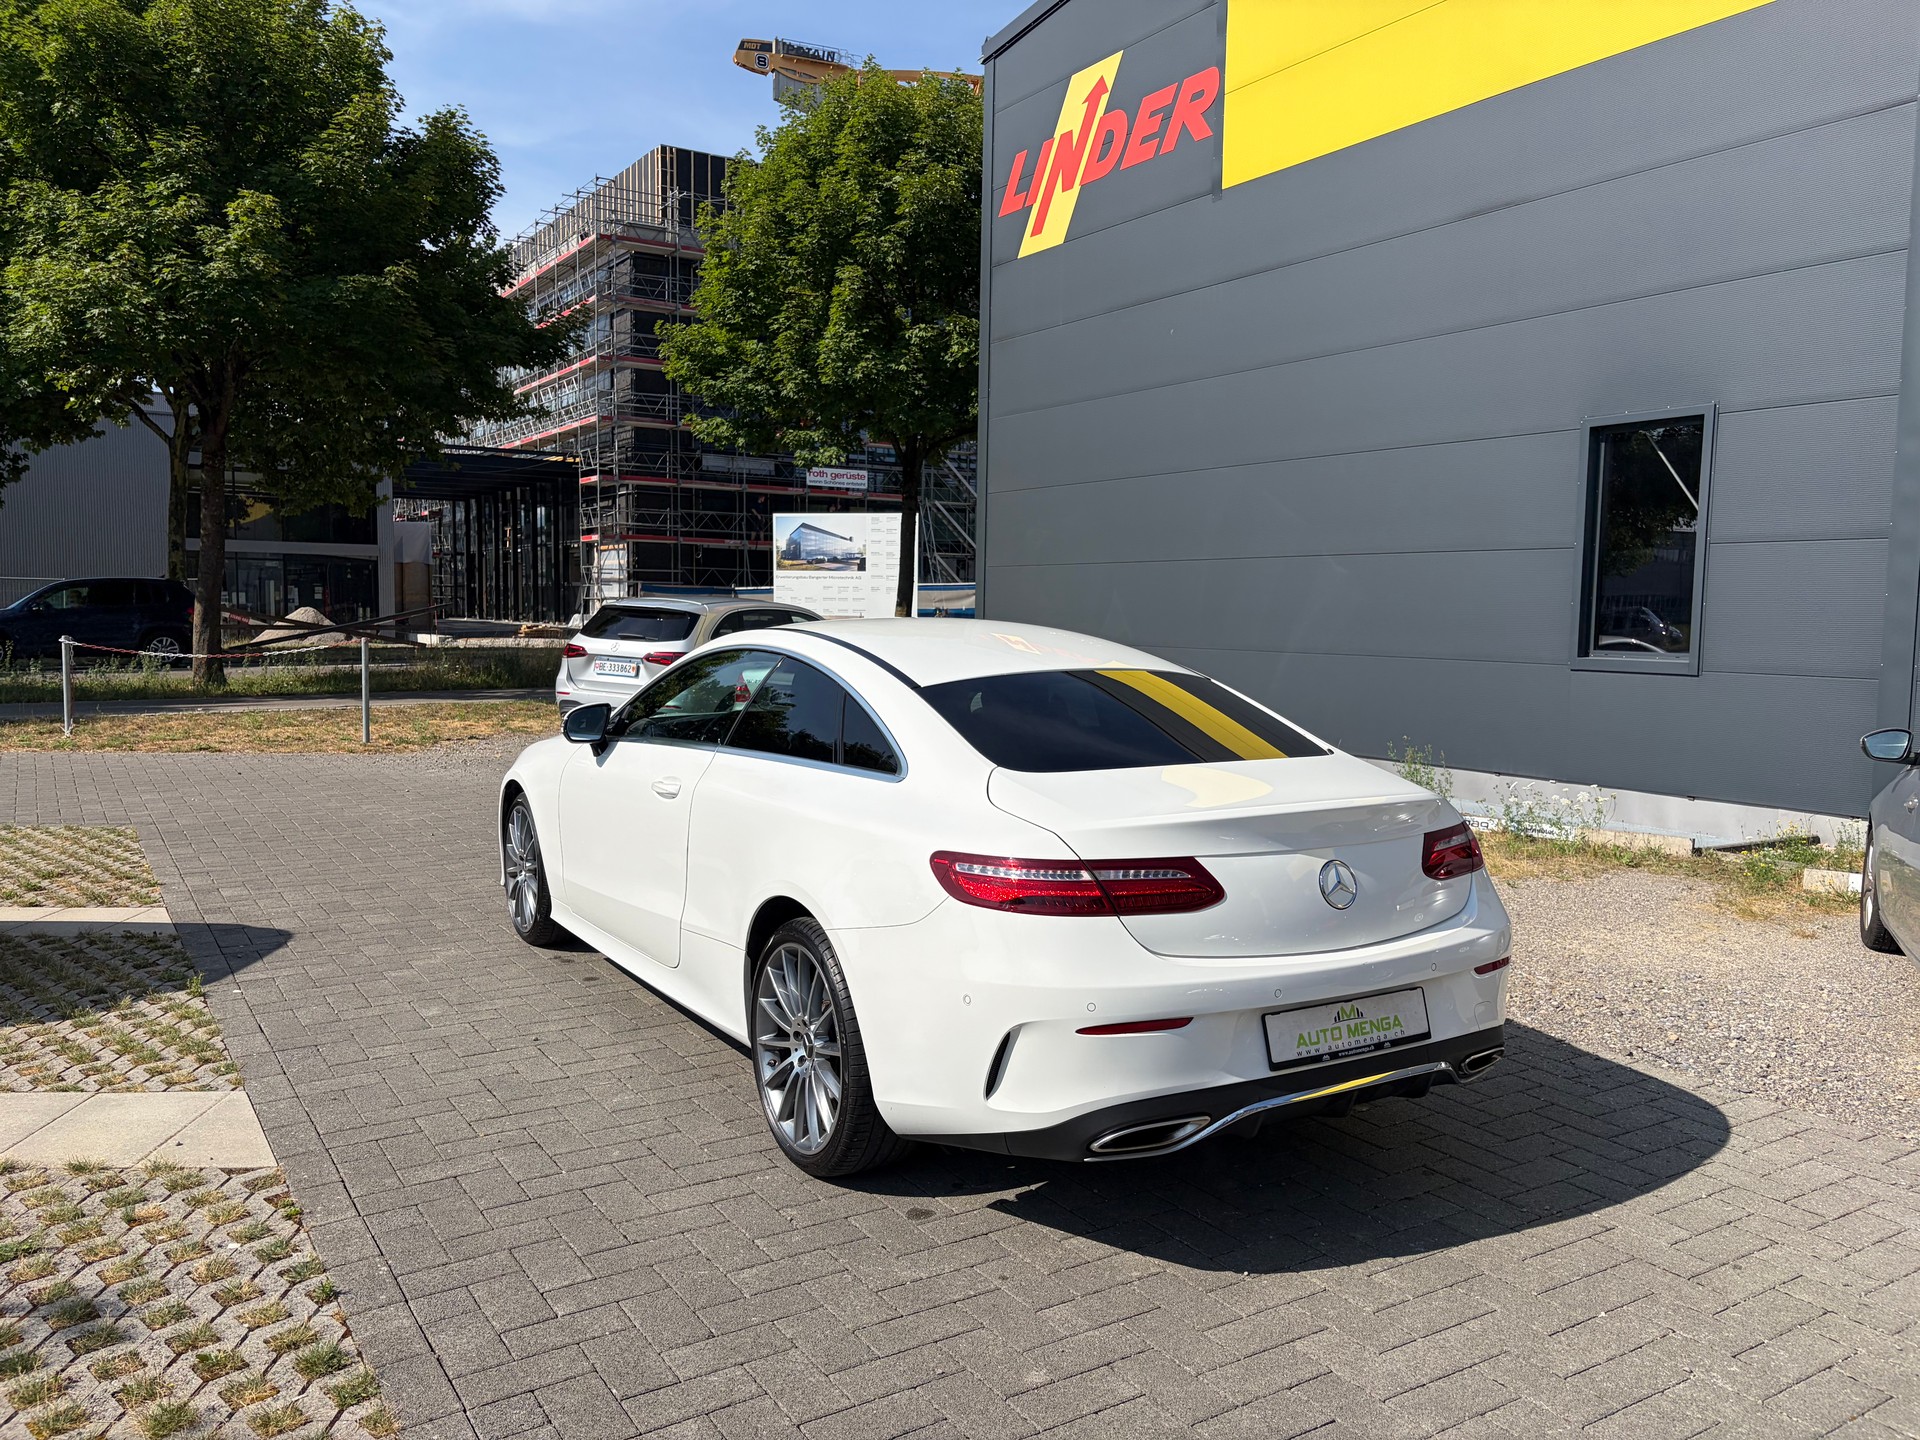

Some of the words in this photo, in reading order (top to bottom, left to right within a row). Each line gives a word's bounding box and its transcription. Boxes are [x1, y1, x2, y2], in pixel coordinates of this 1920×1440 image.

[743, 42, 761, 50] MDT
[998, 66, 1220, 238] LINDER
[808, 470, 828, 478] roth
[830, 472, 866, 481] gerüste
[1296, 1025, 1343, 1049] AUTO
[1347, 1014, 1404, 1039] MENGA
[1296, 1029, 1406, 1057] www.automenga.ch
